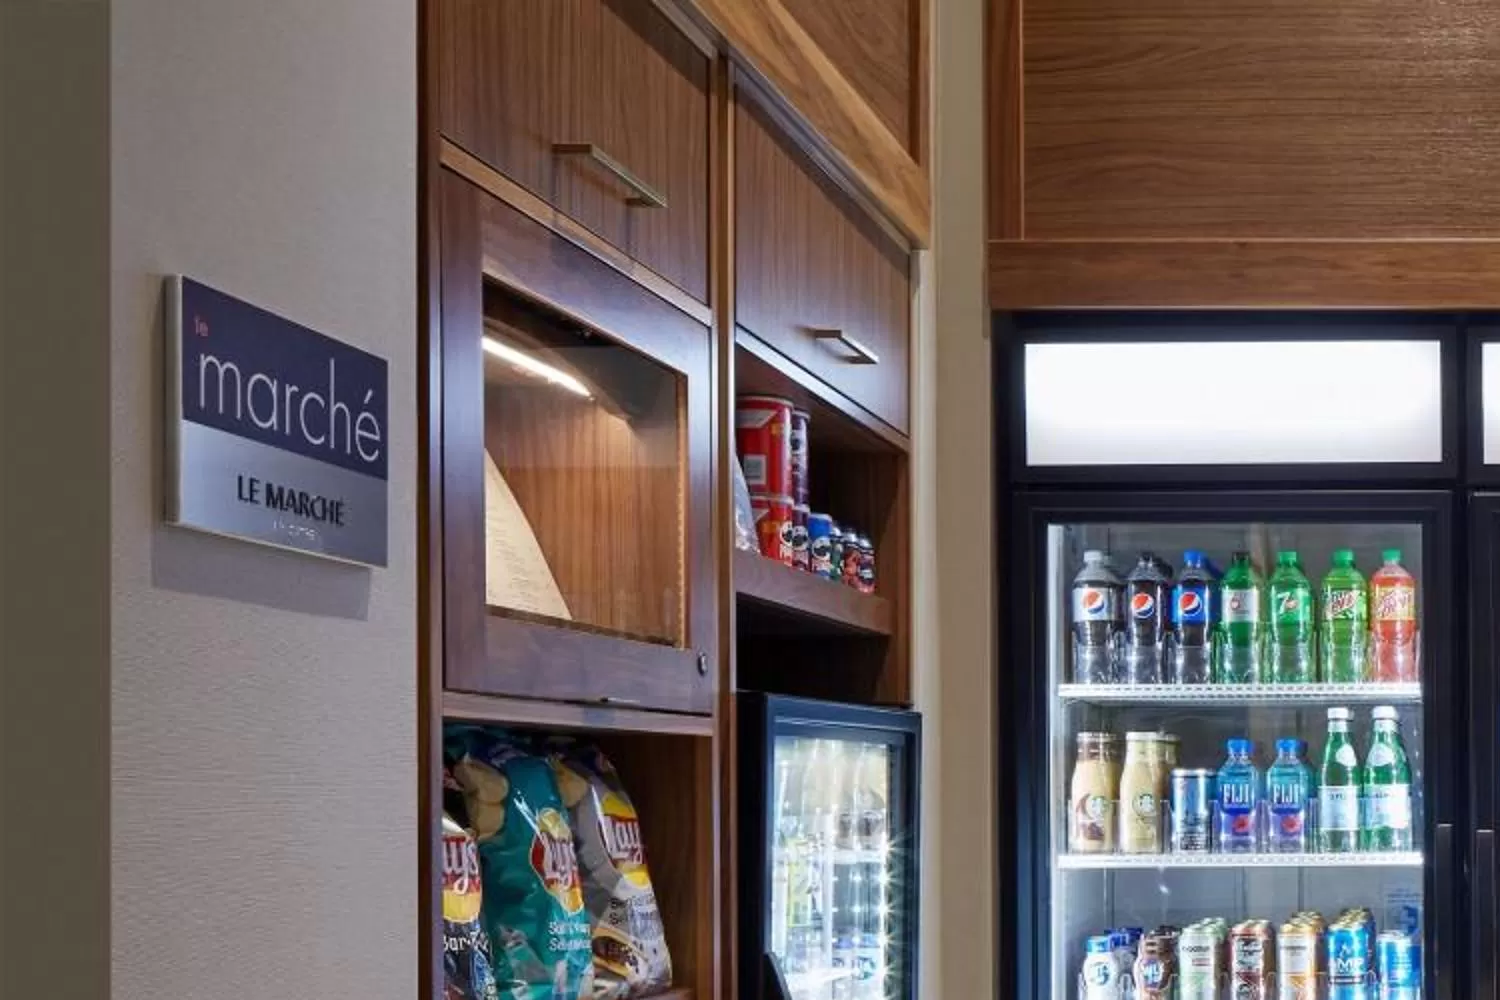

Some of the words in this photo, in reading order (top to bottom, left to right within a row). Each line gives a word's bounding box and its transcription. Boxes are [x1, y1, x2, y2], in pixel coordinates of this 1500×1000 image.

[200, 353, 381, 462] marché
[237, 475, 261, 504] LE
[265, 482, 345, 527] MARCHE
[1223, 784, 1249, 803] FIJI
[1273, 784, 1299, 803] FIJI
